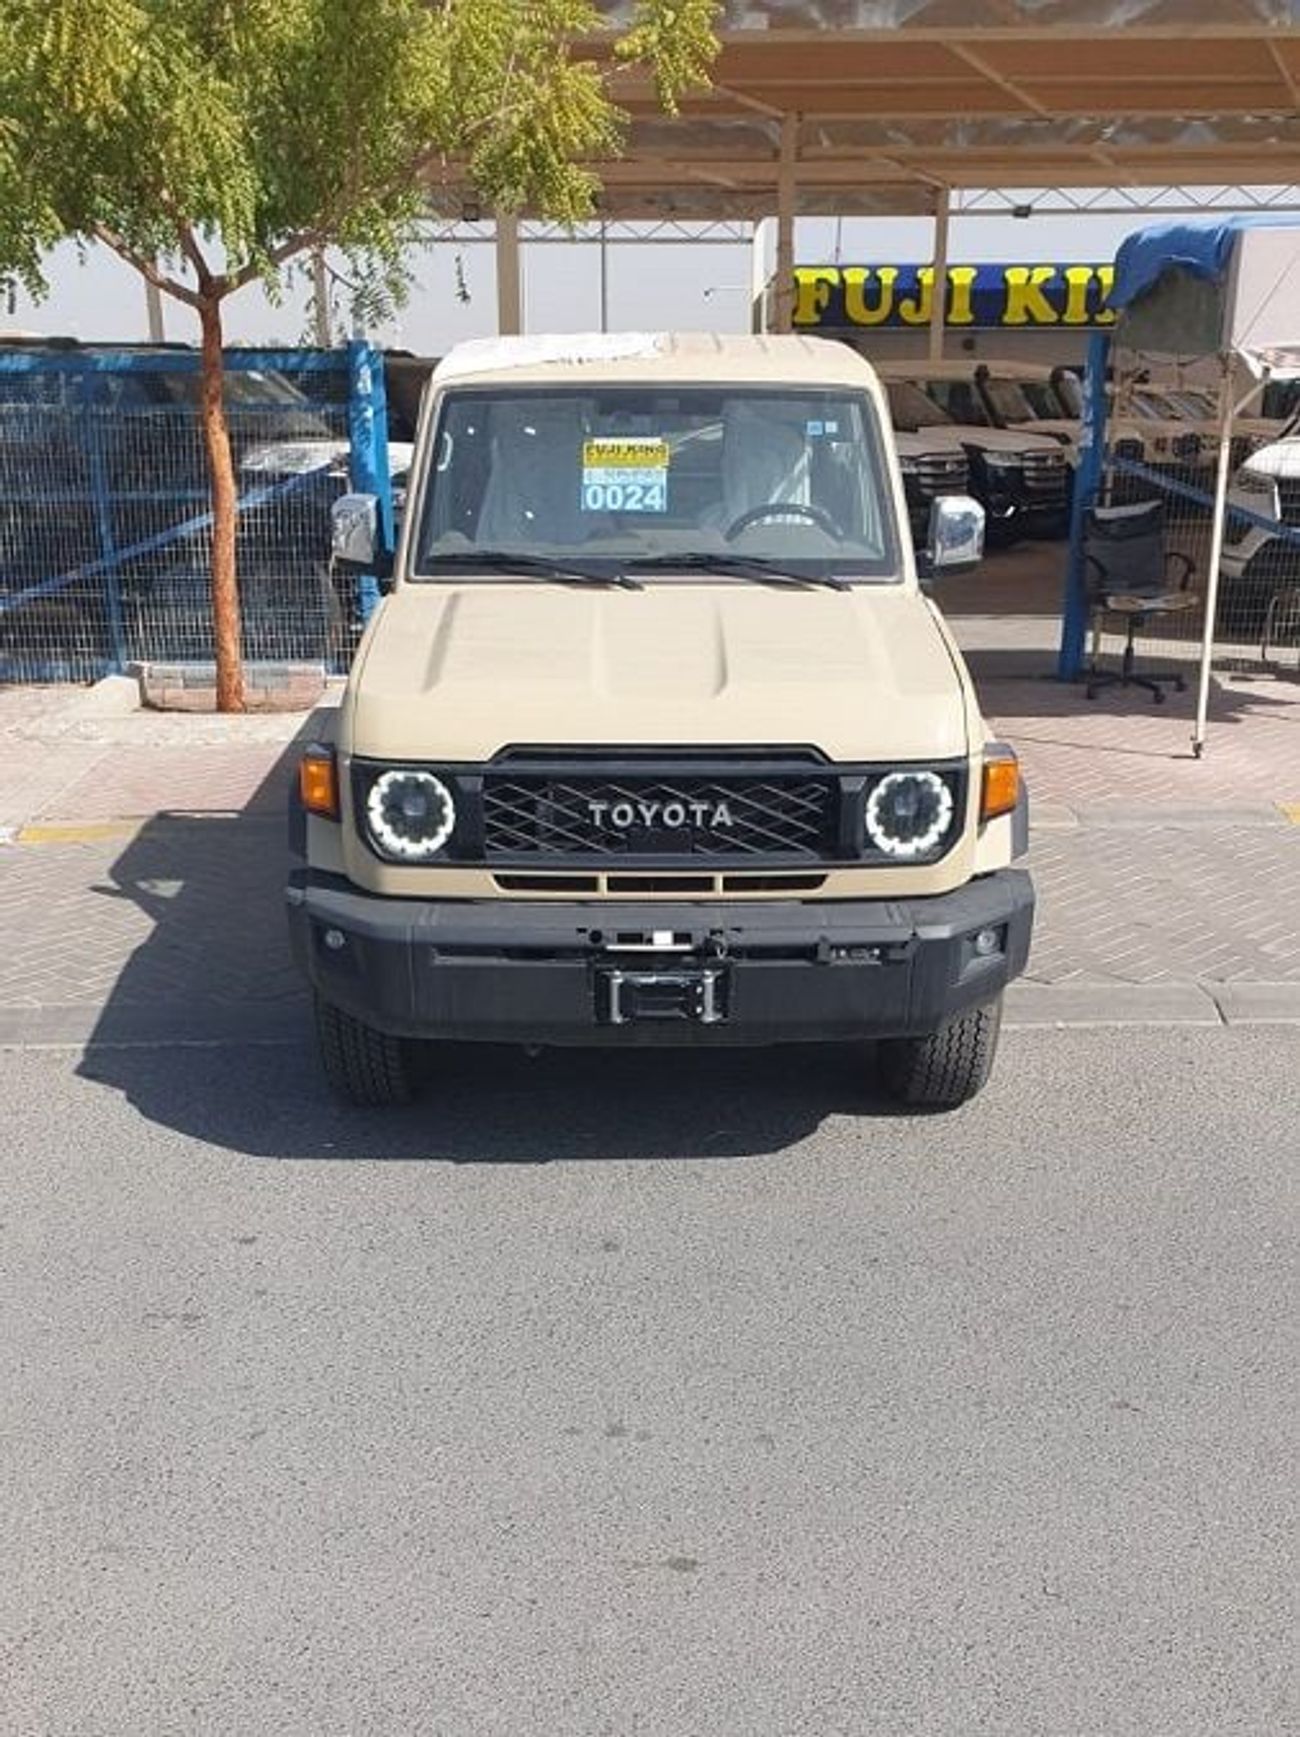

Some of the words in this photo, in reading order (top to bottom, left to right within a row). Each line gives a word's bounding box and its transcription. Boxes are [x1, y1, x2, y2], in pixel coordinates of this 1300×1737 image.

[794, 266, 977, 324] FUJI
[585, 485, 662, 511] 0024
[588, 803, 733, 827] TOYOTA
